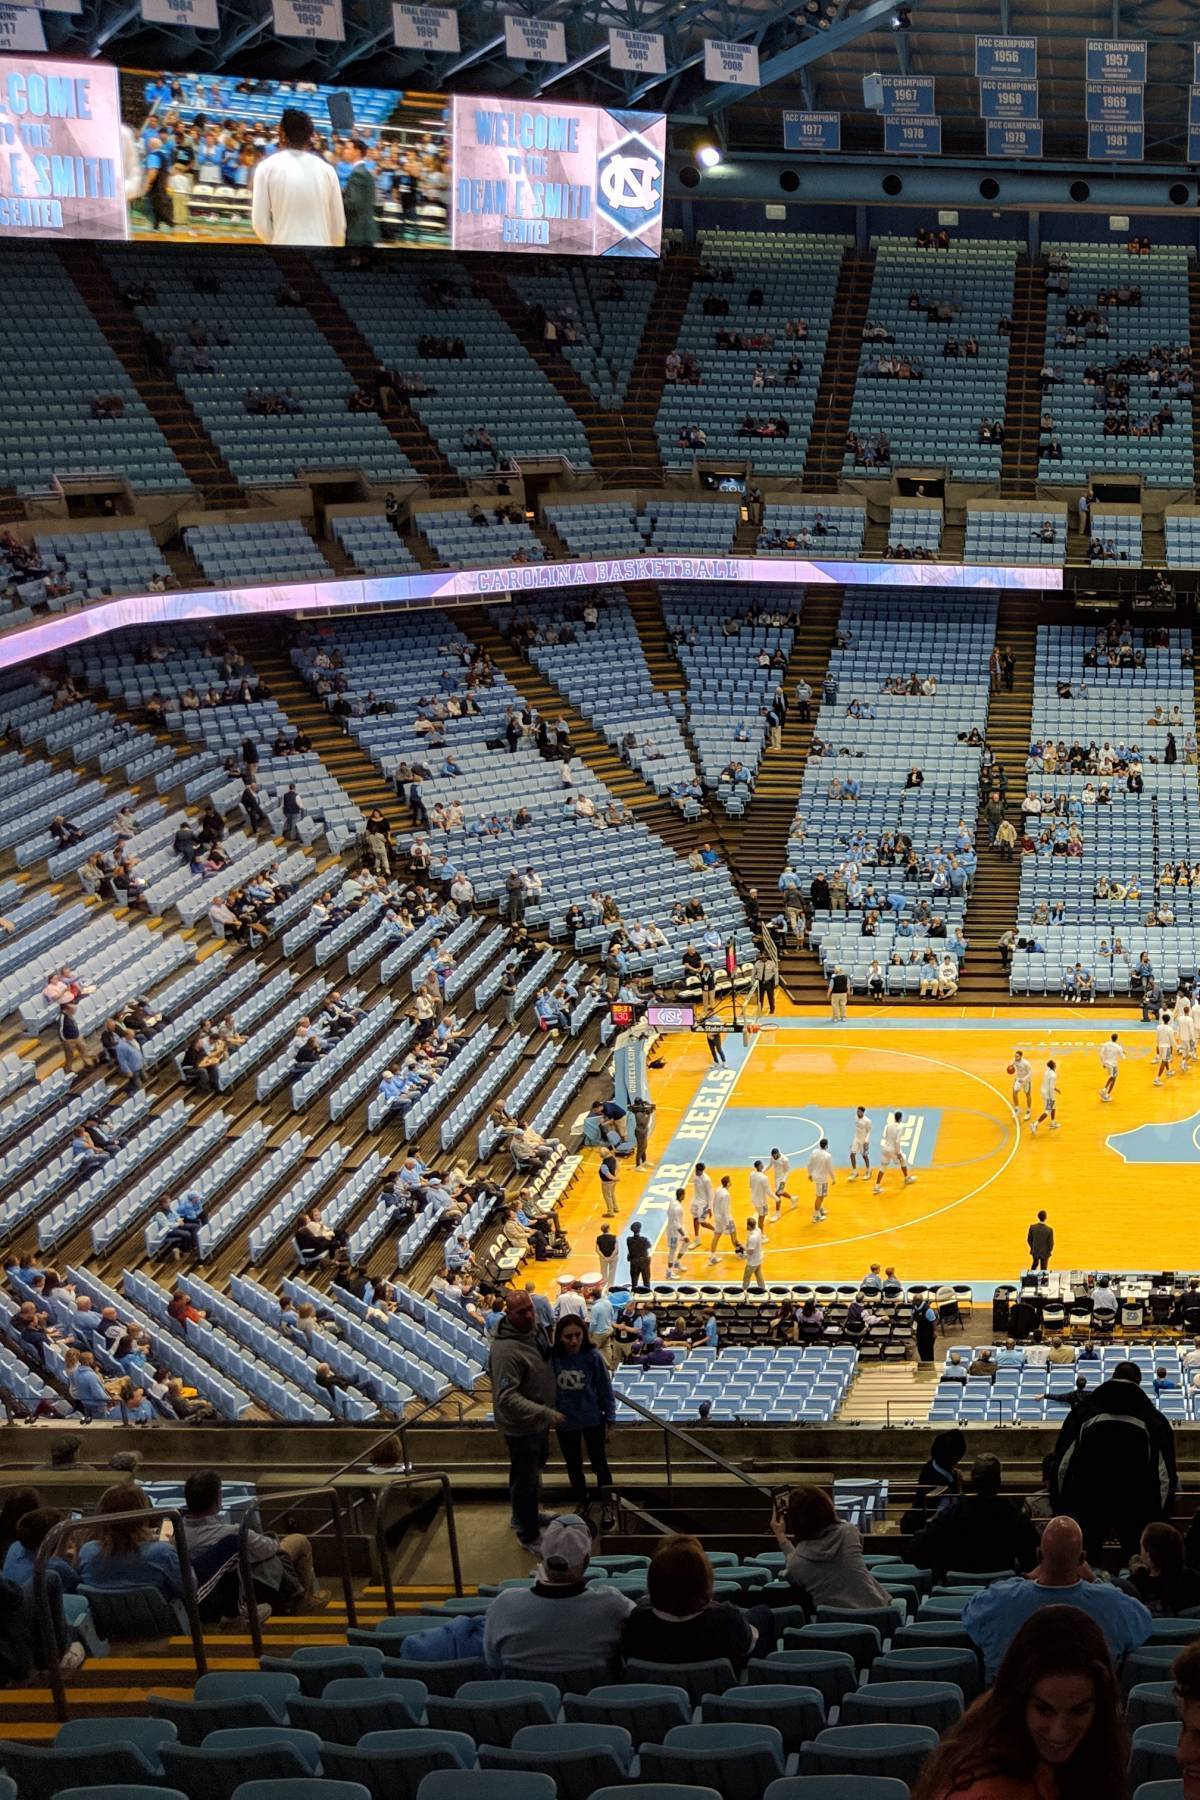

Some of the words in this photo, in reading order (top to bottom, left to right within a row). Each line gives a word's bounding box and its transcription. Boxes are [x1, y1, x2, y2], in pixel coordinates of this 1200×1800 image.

[978, 39, 993, 47] ACC
[994, 40, 1034, 48] CHAMPIONS
[1088, 42, 1103, 50] ACC
[1104, 42, 1144, 52] CHAMPIONS
[994, 51, 1019, 62] 1956
[1105, 54, 1128, 66] 1957
[722, 60, 743, 72] 2008
[998, 83, 1036, 91] CHAMPIONS
[1103, 86, 1142, 94] CHAMPIONS
[0, 72, 92, 120] COME
[895, 90, 917, 100] 1967
[800, 115, 838, 123] CHAMPIONS
[901, 118, 939, 126] CHAMPIONS
[475, 110, 580, 153] WELCOME
[802, 124, 822, 135] 1977
[903, 128, 924, 139] 1978
[1105, 124, 1143, 132] CHAMPIONS
[19, 123, 52, 148] THE
[1004, 132, 1025, 143] 1979
[1107, 135, 1127, 146] 1981
[507, 155, 524, 174] TO
[527, 156, 548, 176] THE
[9, 152, 25, 194] E
[34, 153, 118, 200] SMITH
[459, 176, 508, 215] DEAN
[515, 181, 527, 217] E
[532, 182, 592, 220] SMITH
[503, 218, 550, 245] CENTER
[476, 566, 587, 592] CAROLINA
[596, 558, 738, 582] BASKETBALL
[636, 1161, 692, 1215] TAR
[676, 1068, 736, 1140] HEELS
